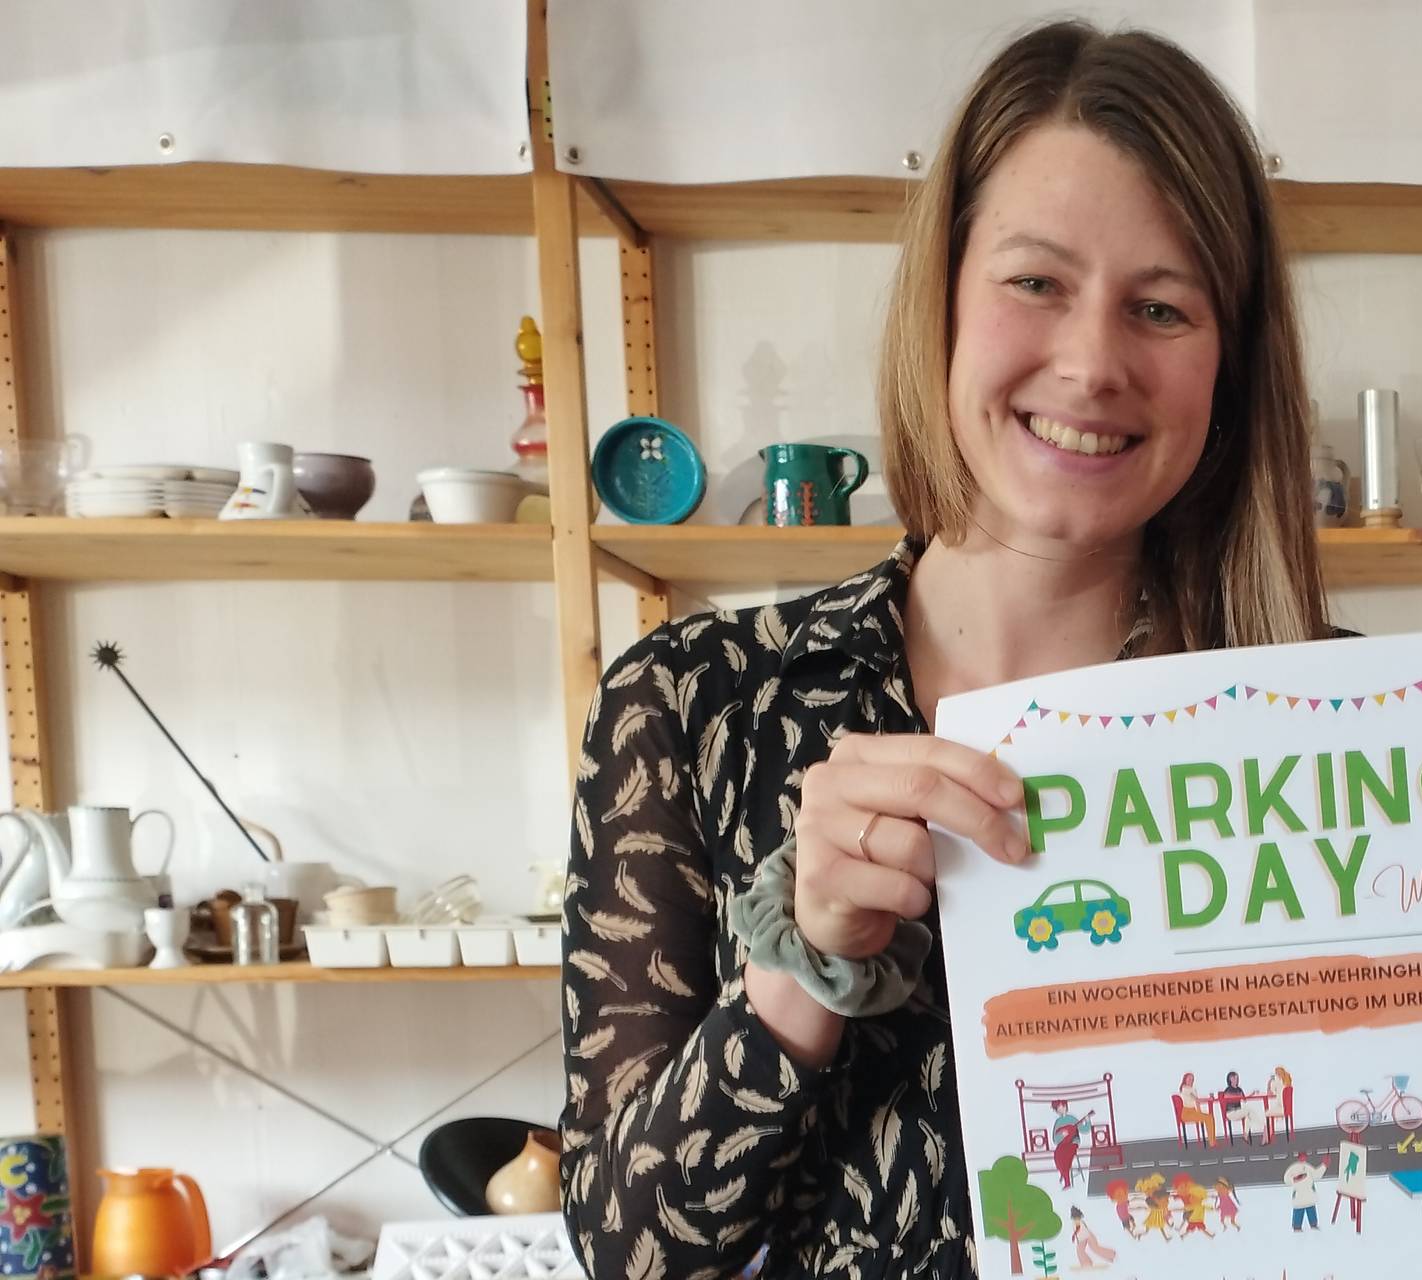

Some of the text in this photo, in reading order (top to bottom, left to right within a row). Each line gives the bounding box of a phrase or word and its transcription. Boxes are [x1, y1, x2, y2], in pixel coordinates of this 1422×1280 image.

[1162, 833, 1371, 931] DAY
[1047, 990, 1077, 1005] EIN
[1083, 978, 1214, 1001] WOCHENENDE
[1220, 975, 1240, 991] IN
[996, 1014, 1108, 1037] ALTERNATIVE
[1115, 997, 1359, 1029] PARKFLÄCHENGESTALTUNG
[1366, 992, 1388, 1010] IM
